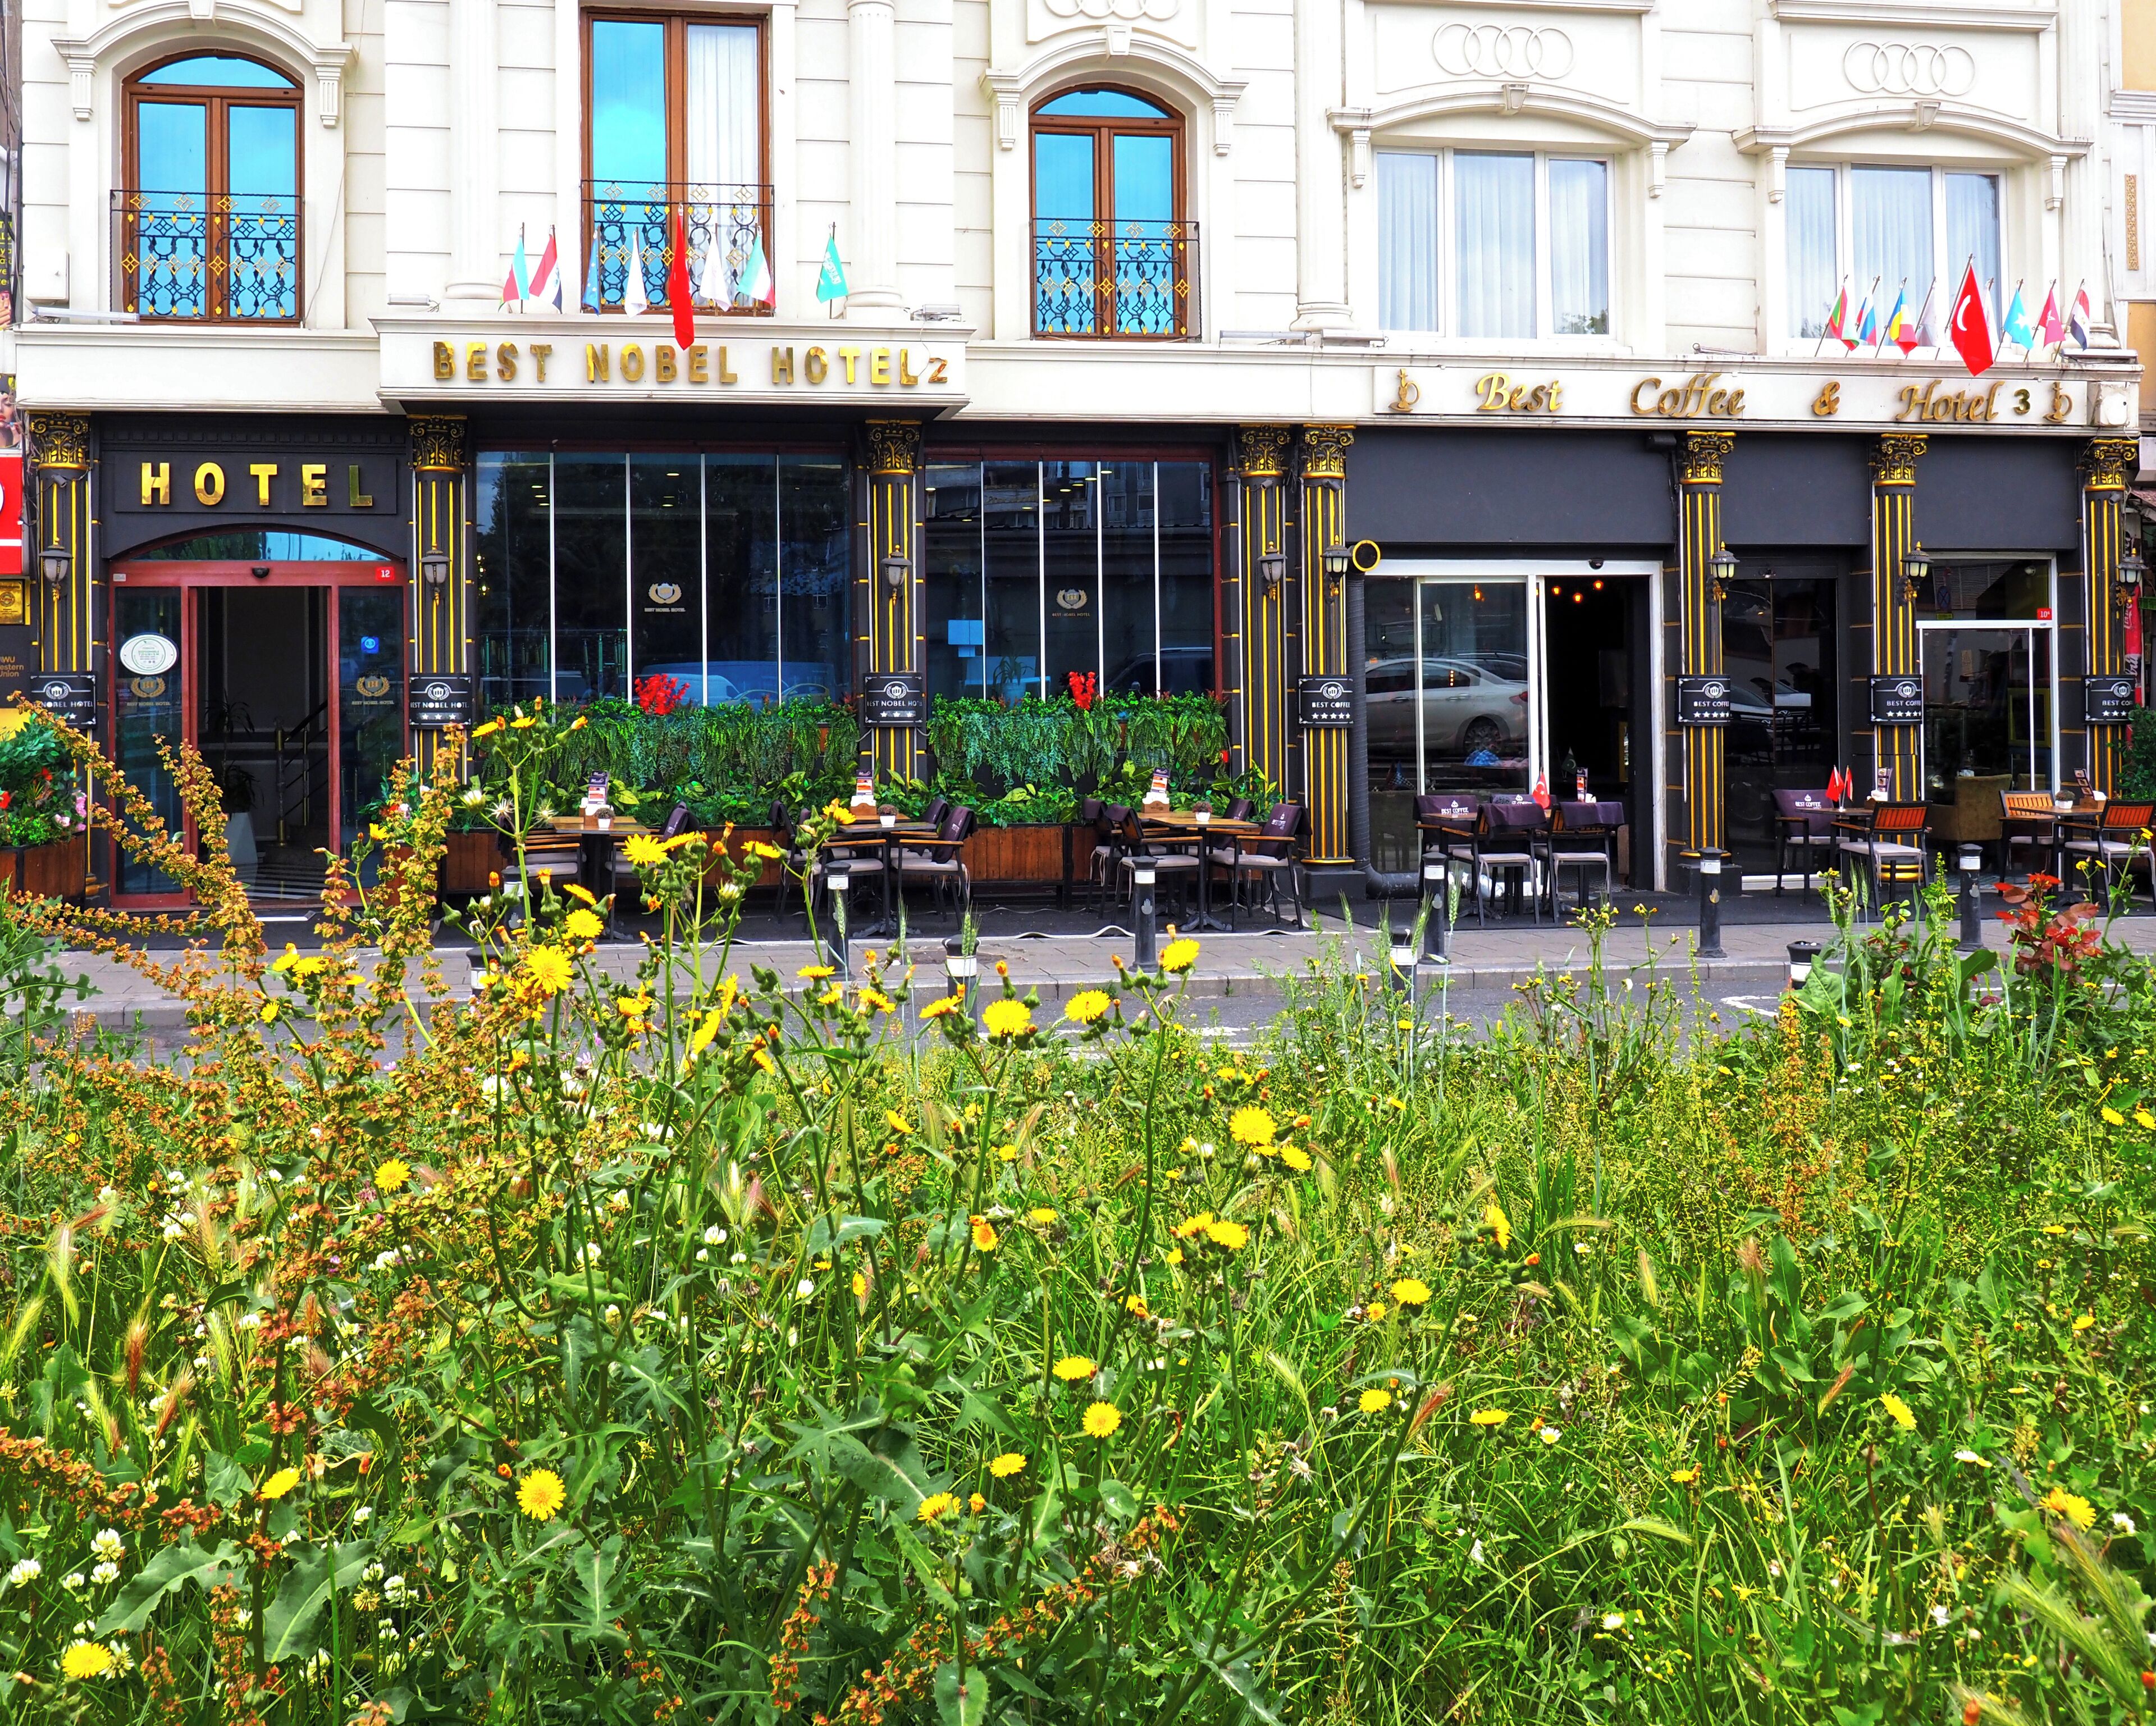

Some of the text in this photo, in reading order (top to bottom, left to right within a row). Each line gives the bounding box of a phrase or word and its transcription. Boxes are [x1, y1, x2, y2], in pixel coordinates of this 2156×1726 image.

[433, 341, 553, 382] BEST
[586, 343, 738, 383] NOBEL
[1476, 372, 2031, 422] Best Coffee & Hotel 3
[141, 462, 373, 507] HOTEL
[381, 569, 390, 578] 12
